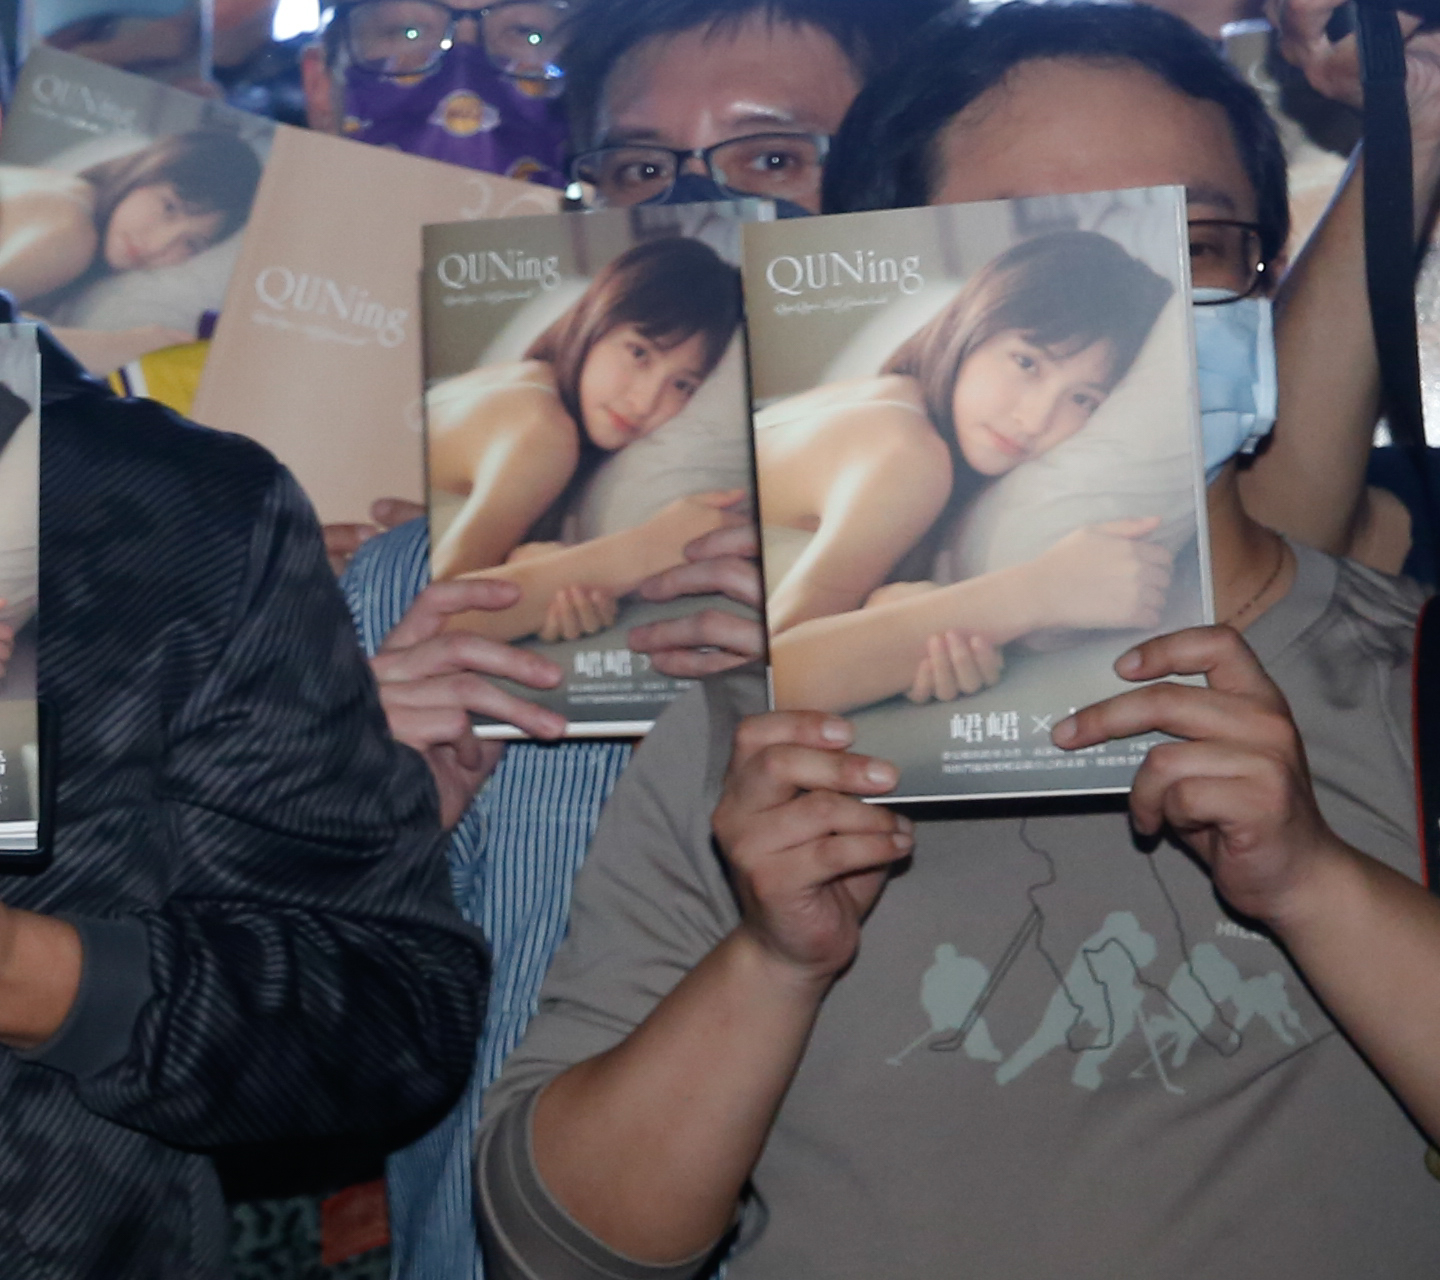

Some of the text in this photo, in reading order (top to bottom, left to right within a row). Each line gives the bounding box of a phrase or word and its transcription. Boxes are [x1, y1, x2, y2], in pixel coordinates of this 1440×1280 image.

[437, 249, 562, 292] QUNing
[766, 250, 924, 296] QUNing
[254, 266, 408, 348] QUNing
